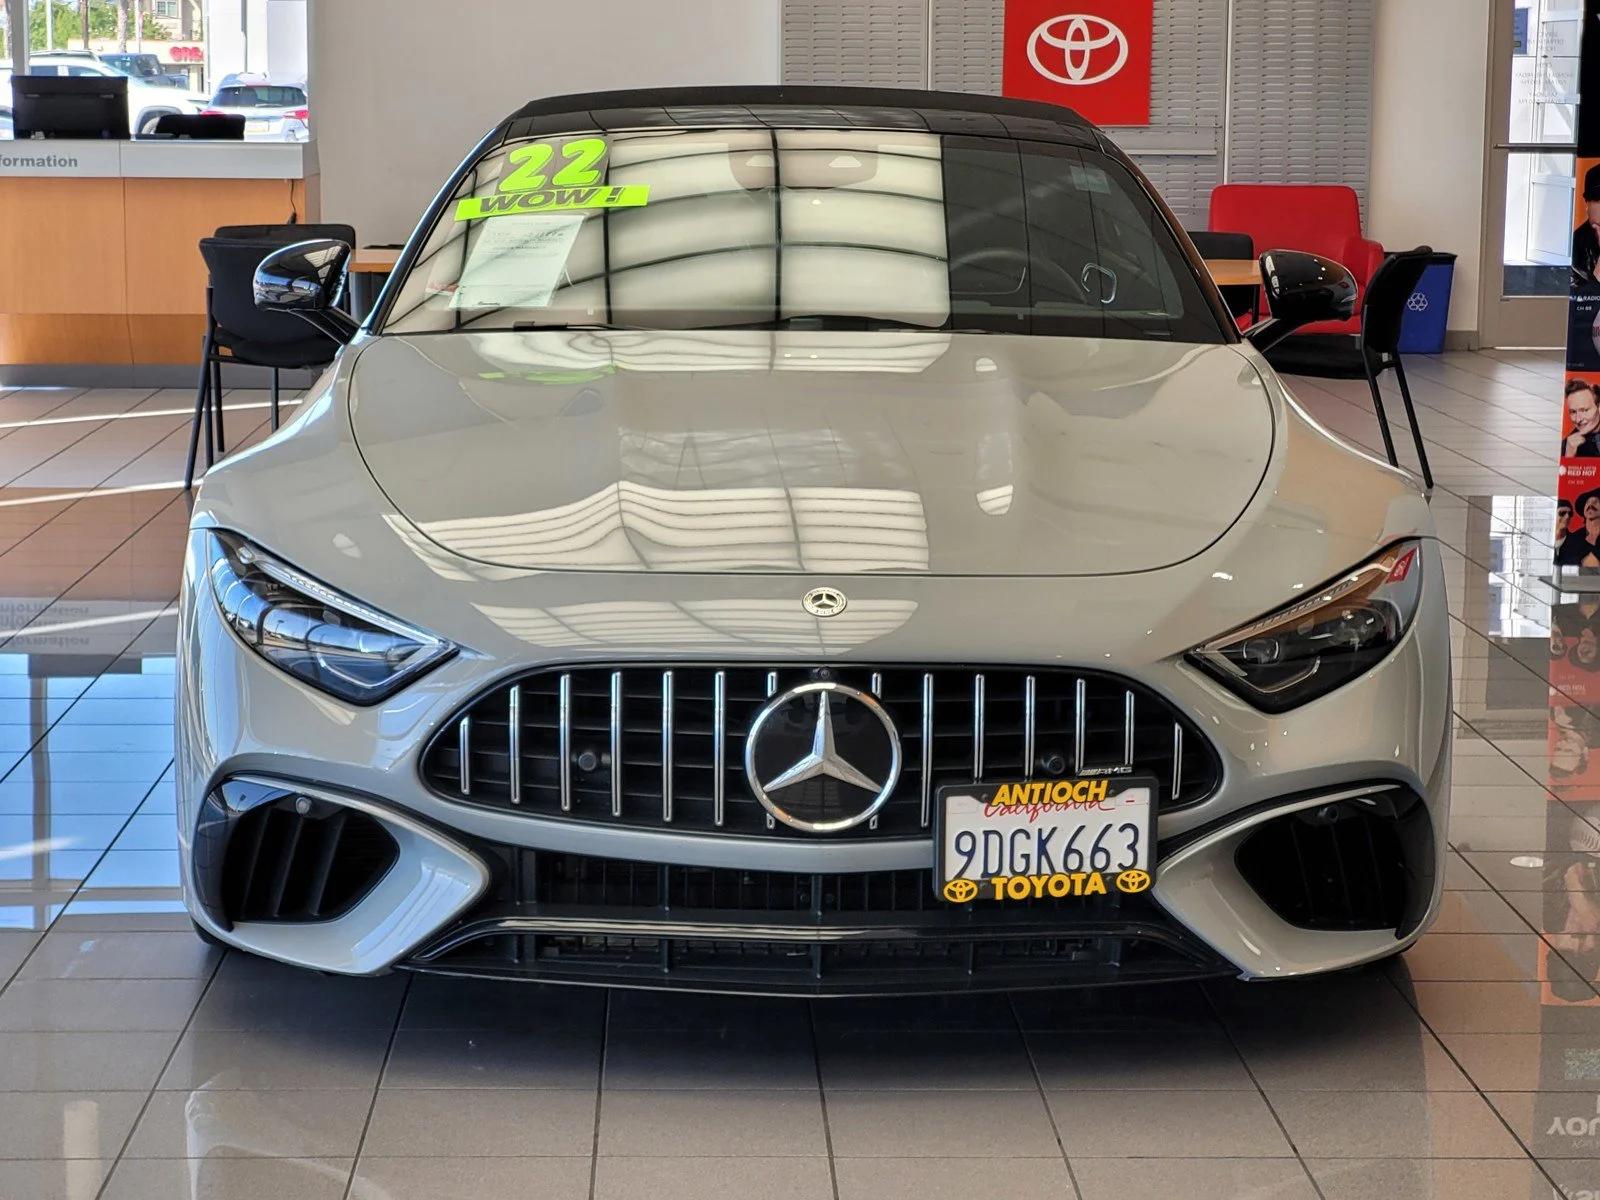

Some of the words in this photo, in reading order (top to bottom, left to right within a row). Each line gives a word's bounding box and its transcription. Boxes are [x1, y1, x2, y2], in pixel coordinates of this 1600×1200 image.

[499, 138, 607, 192] 22
[991, 779, 1108, 806] ANTIOCH
[953, 822, 1139, 880] 9DGK663
[991, 871, 1106, 901] TOYOTA
